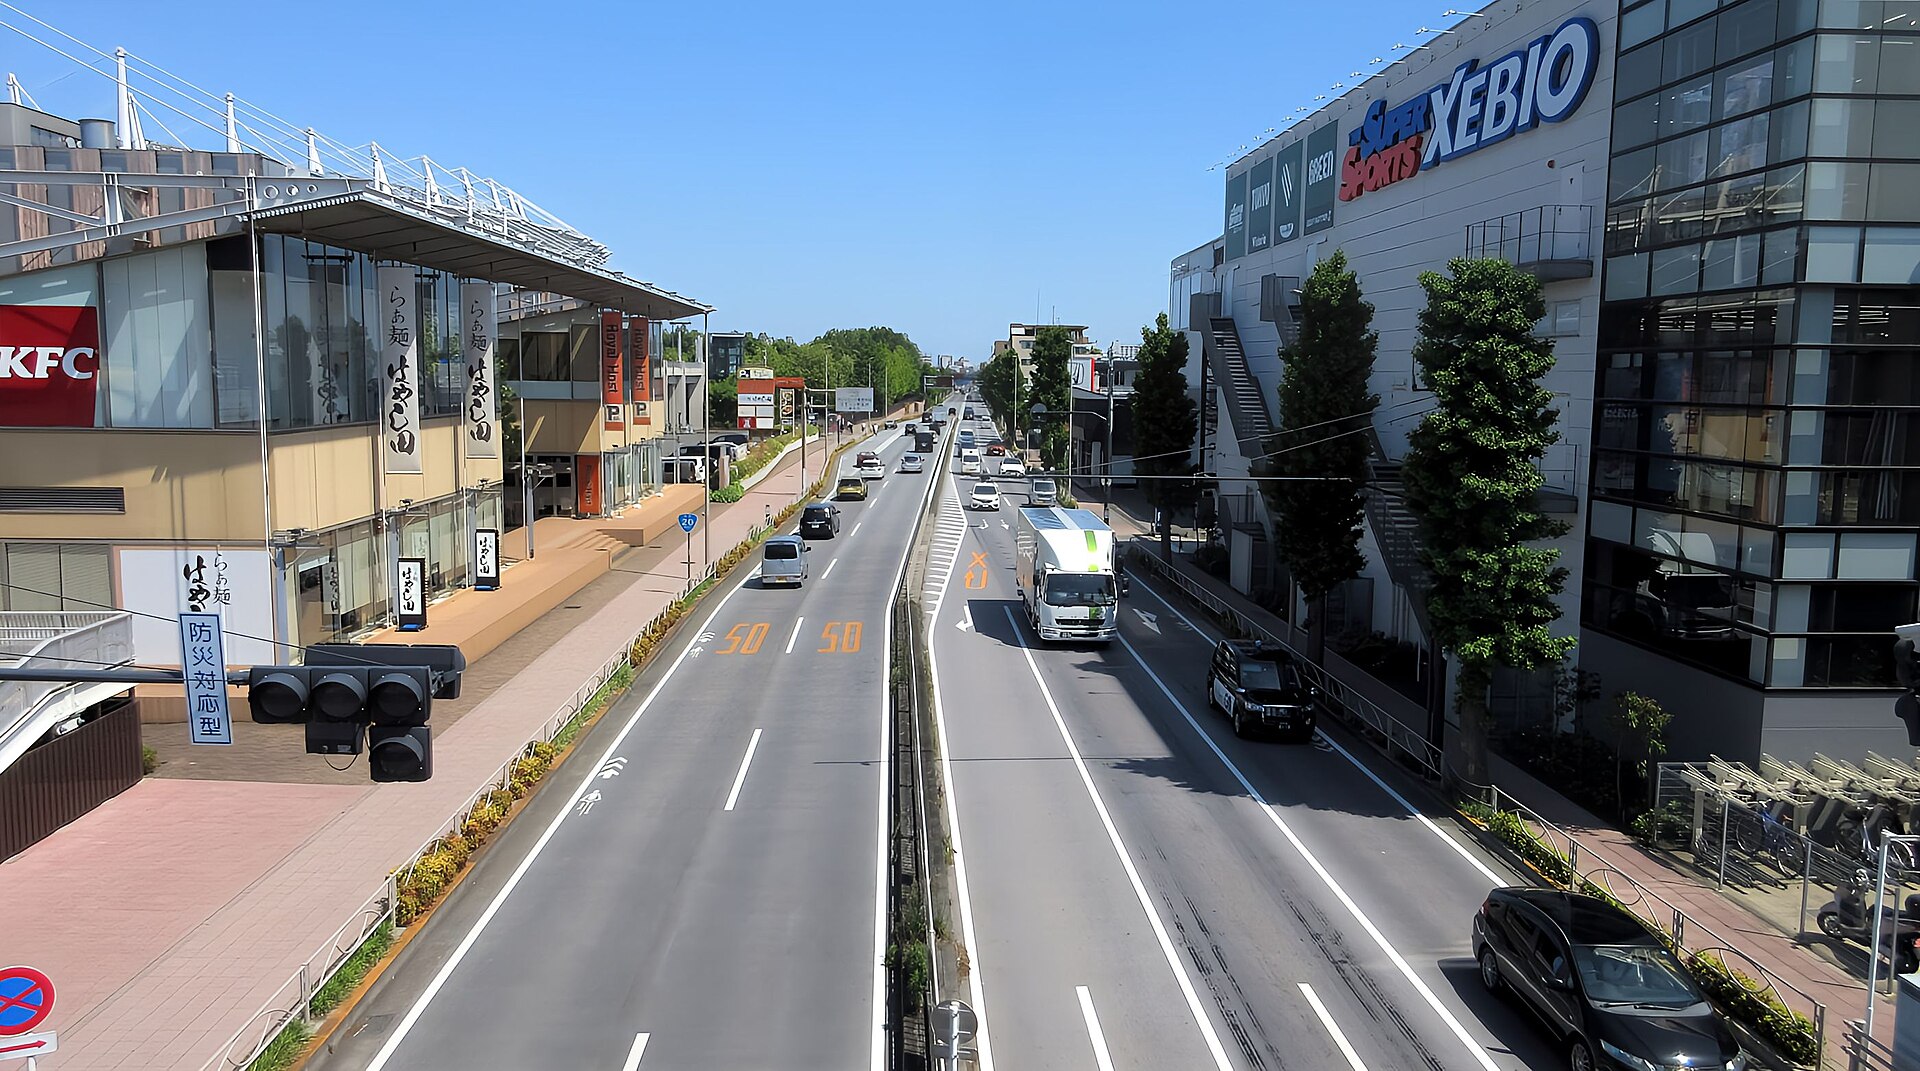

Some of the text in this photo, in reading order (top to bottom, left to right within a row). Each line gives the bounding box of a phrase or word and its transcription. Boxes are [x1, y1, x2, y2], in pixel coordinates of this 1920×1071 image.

[1362, 93, 1431, 159] SUPER
[1420, 17, 1600, 171] XEBIO
[1338, 134, 1424, 202] SPORTS
[0, 346, 95, 380] KFC
[387, 286, 415, 456] らぁ麺 はやし田
[468, 300, 491, 443] らぁ麺 はやし田
[605, 324, 619, 393] Royal Host
[635, 365, 646, 391] Host
[681, 518, 694, 526] 20
[213, 553, 232, 605] らぁ麺
[714, 621, 771, 655] 50
[817, 621, 864, 653] 50
[189, 622, 222, 736] 防災対応型
